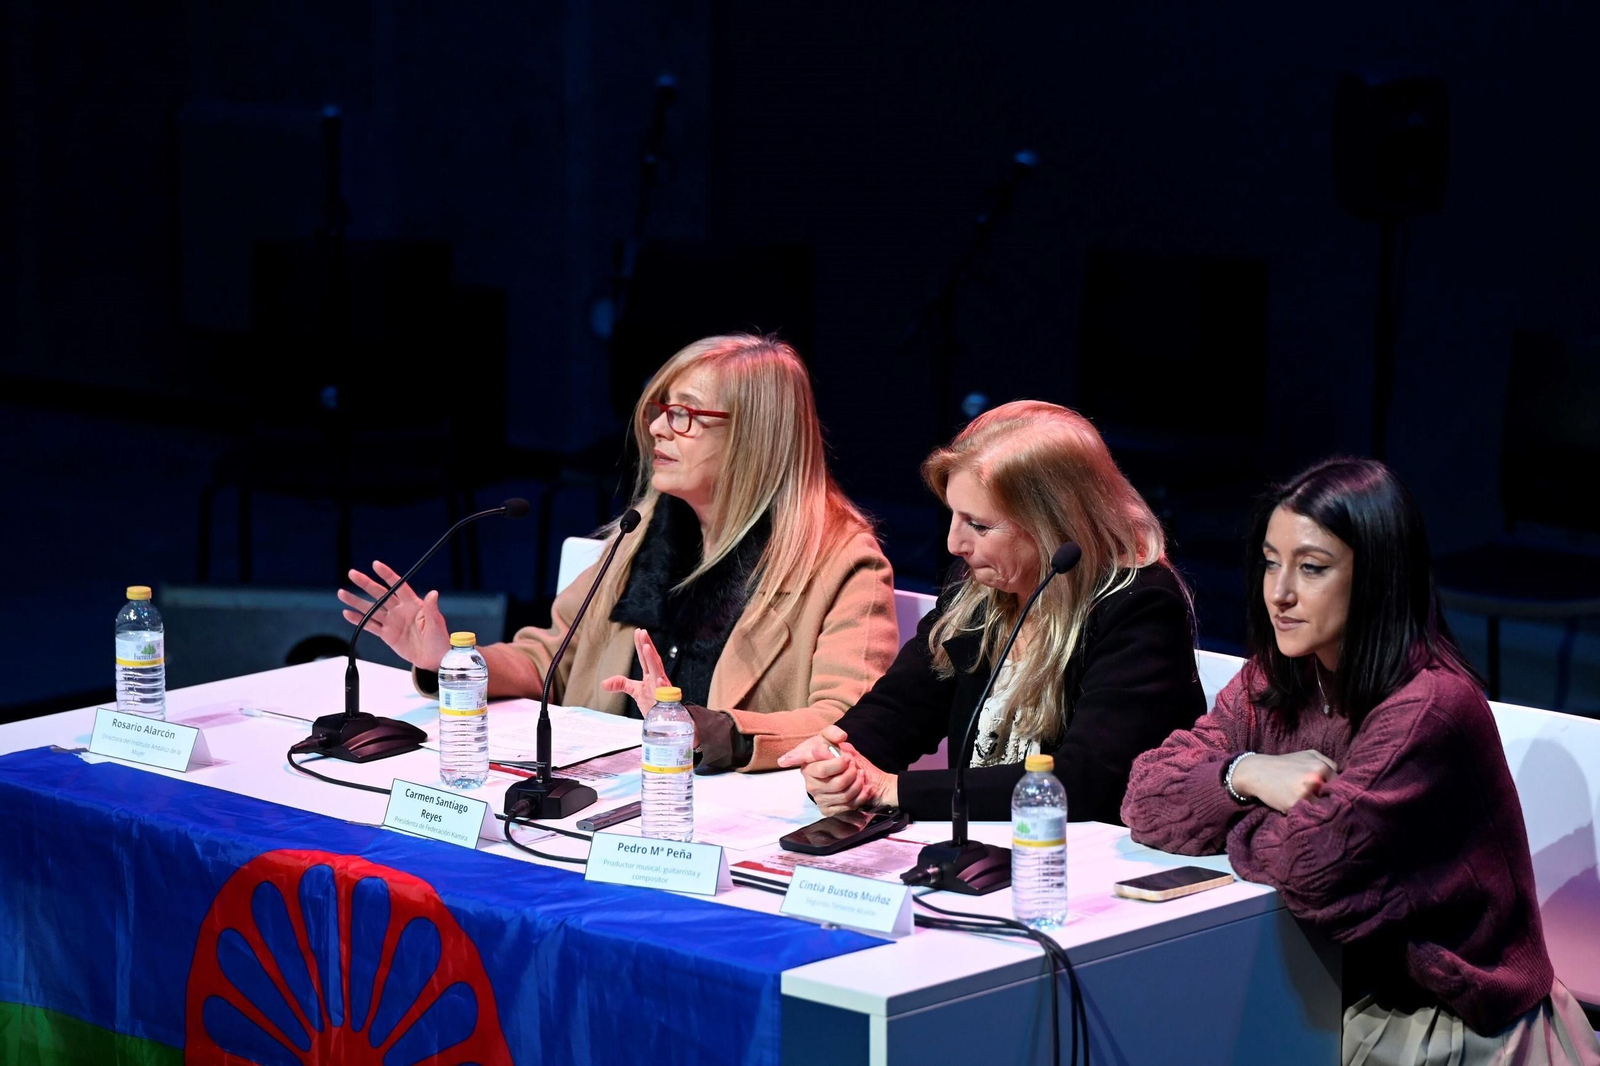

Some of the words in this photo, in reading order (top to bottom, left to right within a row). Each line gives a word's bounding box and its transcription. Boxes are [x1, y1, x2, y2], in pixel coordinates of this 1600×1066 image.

[112, 718, 142, 732] Rosario
[143, 725, 175, 739] Alarcón
[102, 733, 122, 743] Directora
[123, 737, 131, 745] del
[131, 739, 150, 748] Instituto
[151, 743, 170, 752] Andaluz
[131, 749, 145, 757] Mujer
[405, 788, 434, 804] Carmen
[435, 796, 468, 814] Santiago
[420, 809, 442, 822] Reyes
[394, 816, 418, 828] Presidenta
[425, 824, 450, 836] Federación
[451, 831, 468, 841] Kamira
[617, 842, 647, 854] Pedro
[666, 848, 692, 859] Peña
[603, 859, 635, 869] Productor
[636, 863, 661, 873] musical,
[663, 867, 695, 876] guitarrista
[632, 874, 668, 883] compositor
[799, 879, 825, 892] Cintia
[827, 885, 858, 899] Bustos
[860, 891, 891, 905] Muñoz
